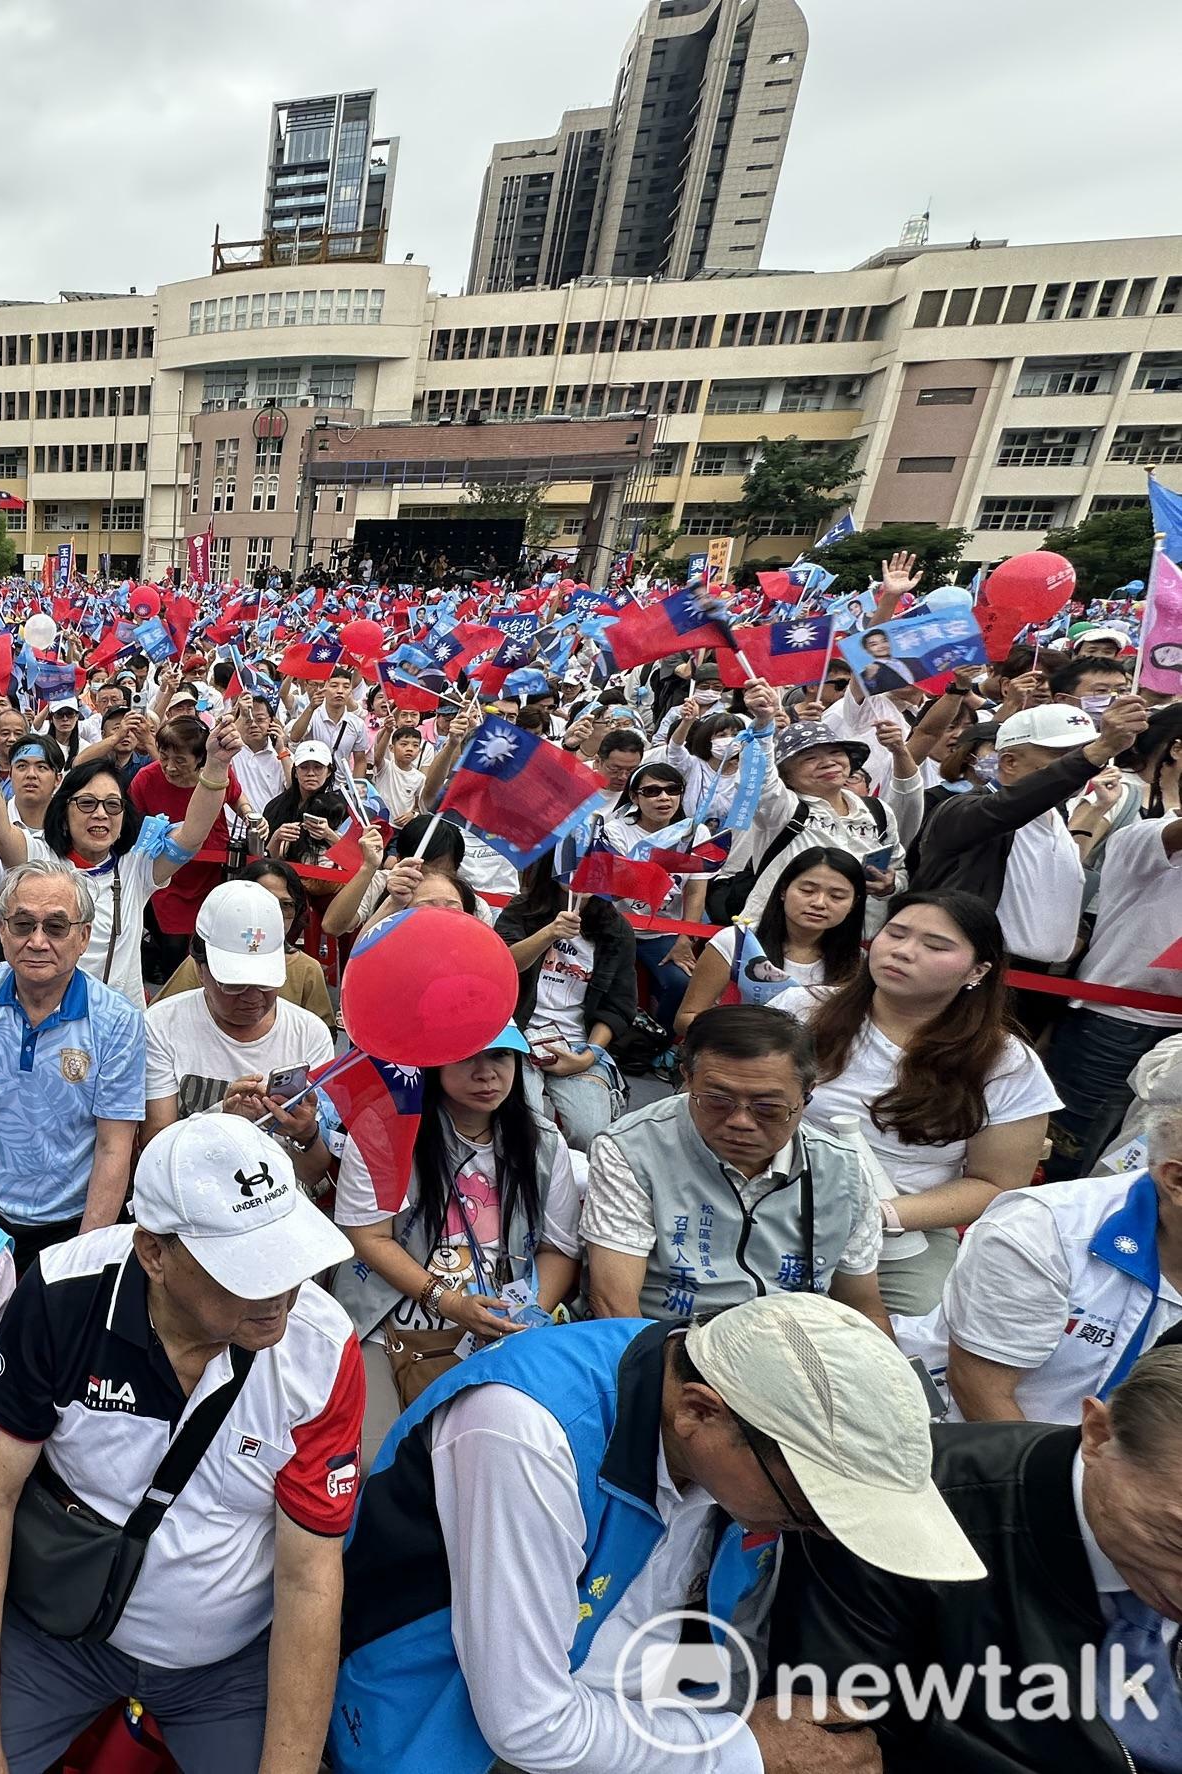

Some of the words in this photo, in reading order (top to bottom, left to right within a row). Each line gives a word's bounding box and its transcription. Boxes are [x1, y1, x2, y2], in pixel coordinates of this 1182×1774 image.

[573, 596, 602, 609] 挺台
[232, 1198, 263, 1213] UNDER
[264, 1184, 289, 1203] ARMOUR
[671, 1214, 690, 1264] 召集人
[698, 1202, 718, 1279] 松山區後援會
[87, 1375, 136, 1404] FILA
